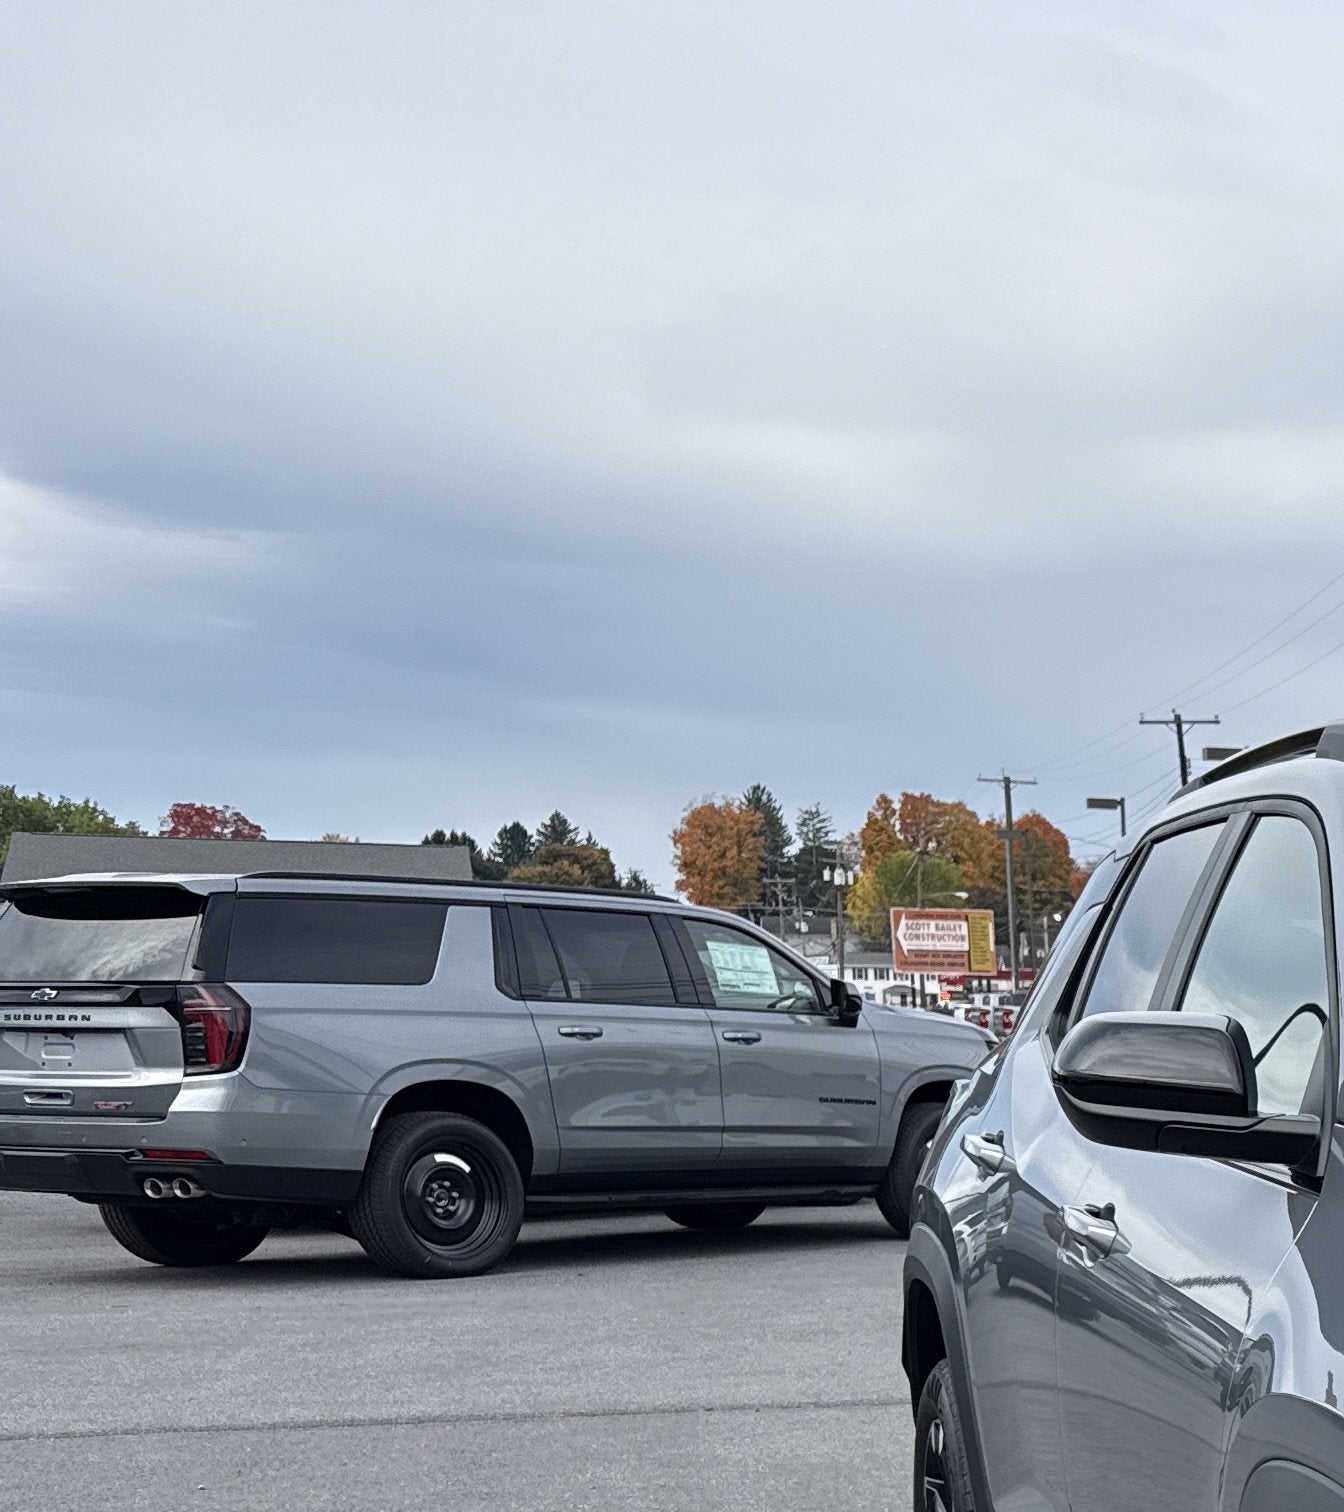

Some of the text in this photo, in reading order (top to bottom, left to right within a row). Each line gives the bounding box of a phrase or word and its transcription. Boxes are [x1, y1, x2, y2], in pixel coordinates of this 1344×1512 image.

[905, 922, 931, 931] SCOTT
[903, 932, 967, 942] CONSTRUCTION
[3, 1013, 91, 1022] SUBURBAN
